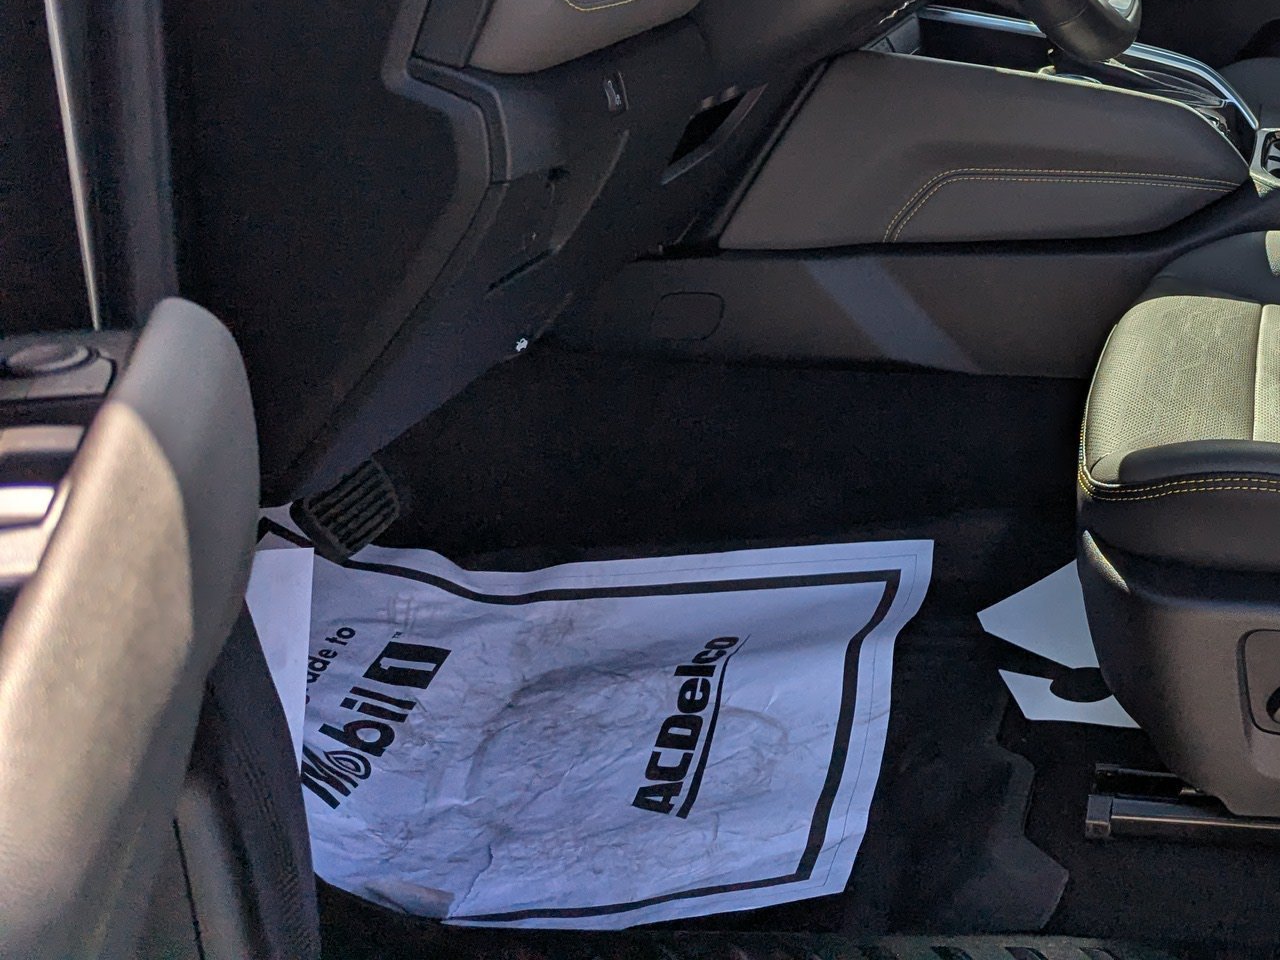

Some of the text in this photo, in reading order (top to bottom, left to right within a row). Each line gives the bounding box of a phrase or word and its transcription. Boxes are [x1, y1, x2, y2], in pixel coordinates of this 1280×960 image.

[325, 627, 356, 646] to
[300, 686, 417, 809] Mobil
[632, 637, 739, 815] ACDelco
